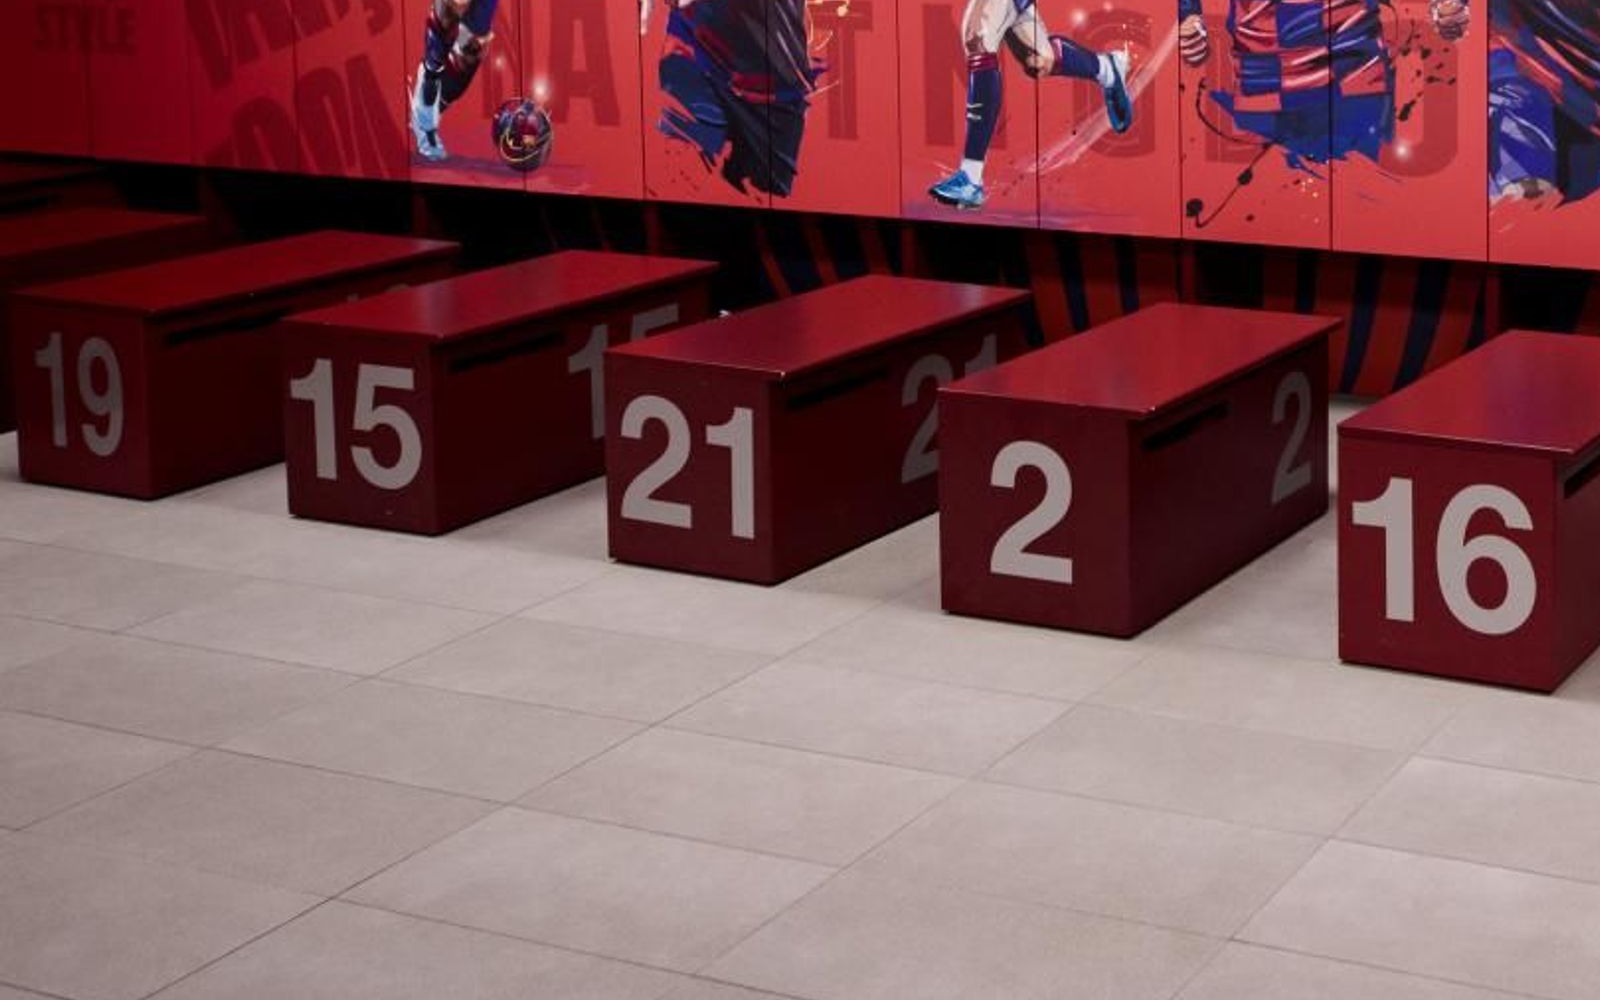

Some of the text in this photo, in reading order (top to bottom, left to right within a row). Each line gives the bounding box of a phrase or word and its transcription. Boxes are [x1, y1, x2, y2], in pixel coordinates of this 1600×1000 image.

[34, 332, 125, 458] 19
[290, 358, 423, 490] 15
[1271, 371, 1313, 505] 2
[620, 394, 756, 540] 21
[989, 441, 1074, 585] 2
[1351, 477, 1538, 636] 16
